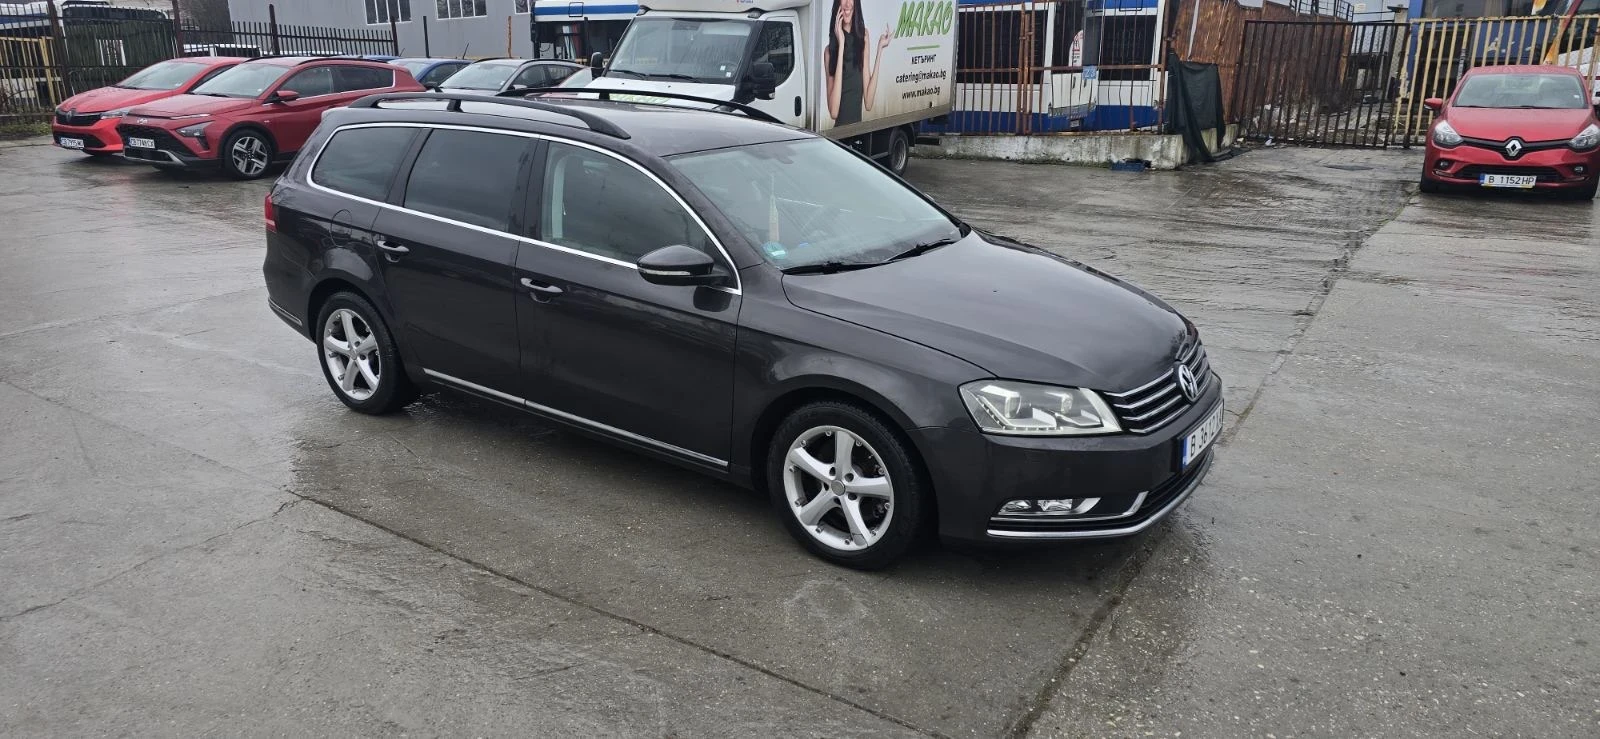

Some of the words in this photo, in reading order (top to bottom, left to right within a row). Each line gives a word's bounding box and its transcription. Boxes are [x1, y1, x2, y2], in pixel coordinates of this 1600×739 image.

[911, 54, 937, 65] КЕТЪРИНГ
[895, 69, 947, 84] catering@makao.bg
[902, 86, 941, 100] www.makao.bg
[1488, 176, 1495, 184] B
